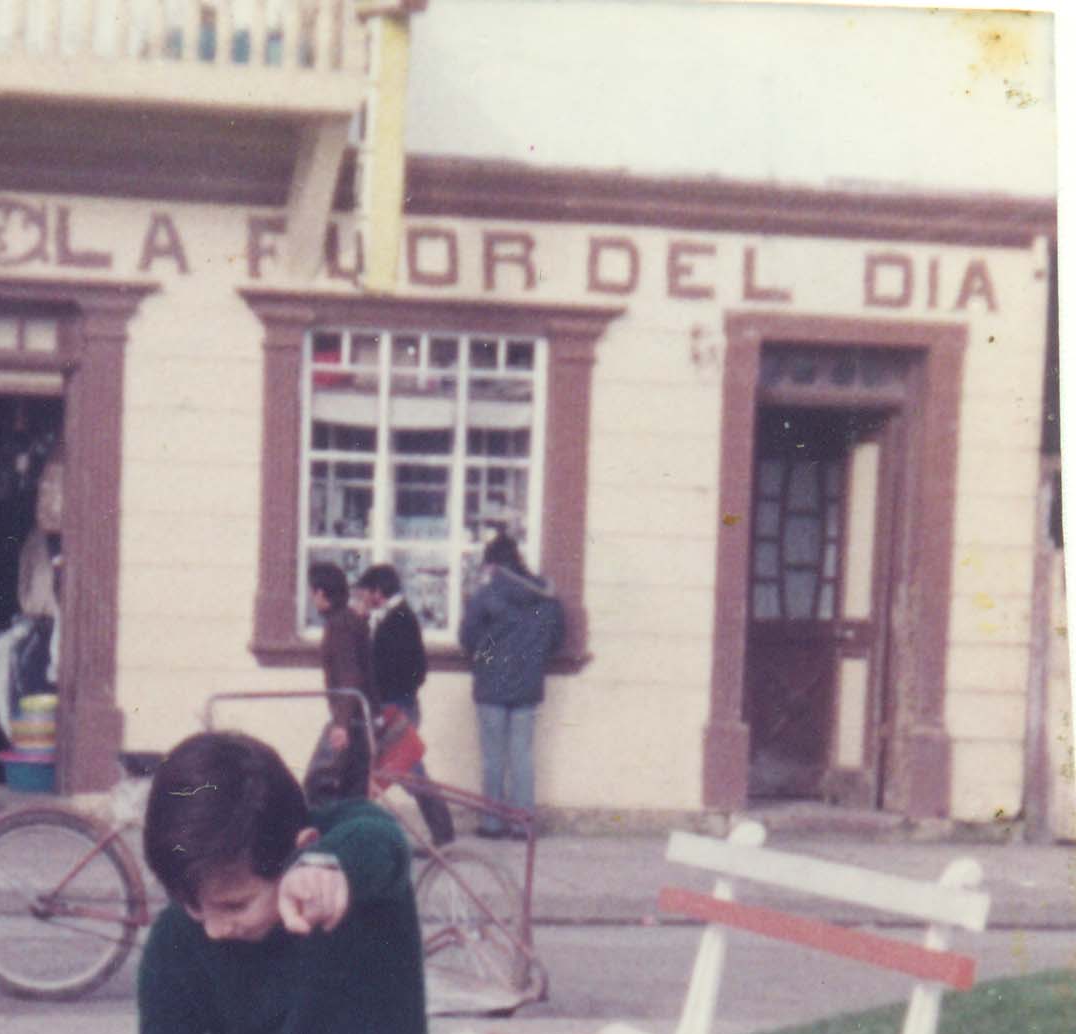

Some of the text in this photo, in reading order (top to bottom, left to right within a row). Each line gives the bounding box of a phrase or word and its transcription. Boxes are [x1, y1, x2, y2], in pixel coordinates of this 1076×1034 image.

[55, 204, 191, 275] LA
[586, 235, 793, 303] DEL
[863, 253, 999, 313] DIA
